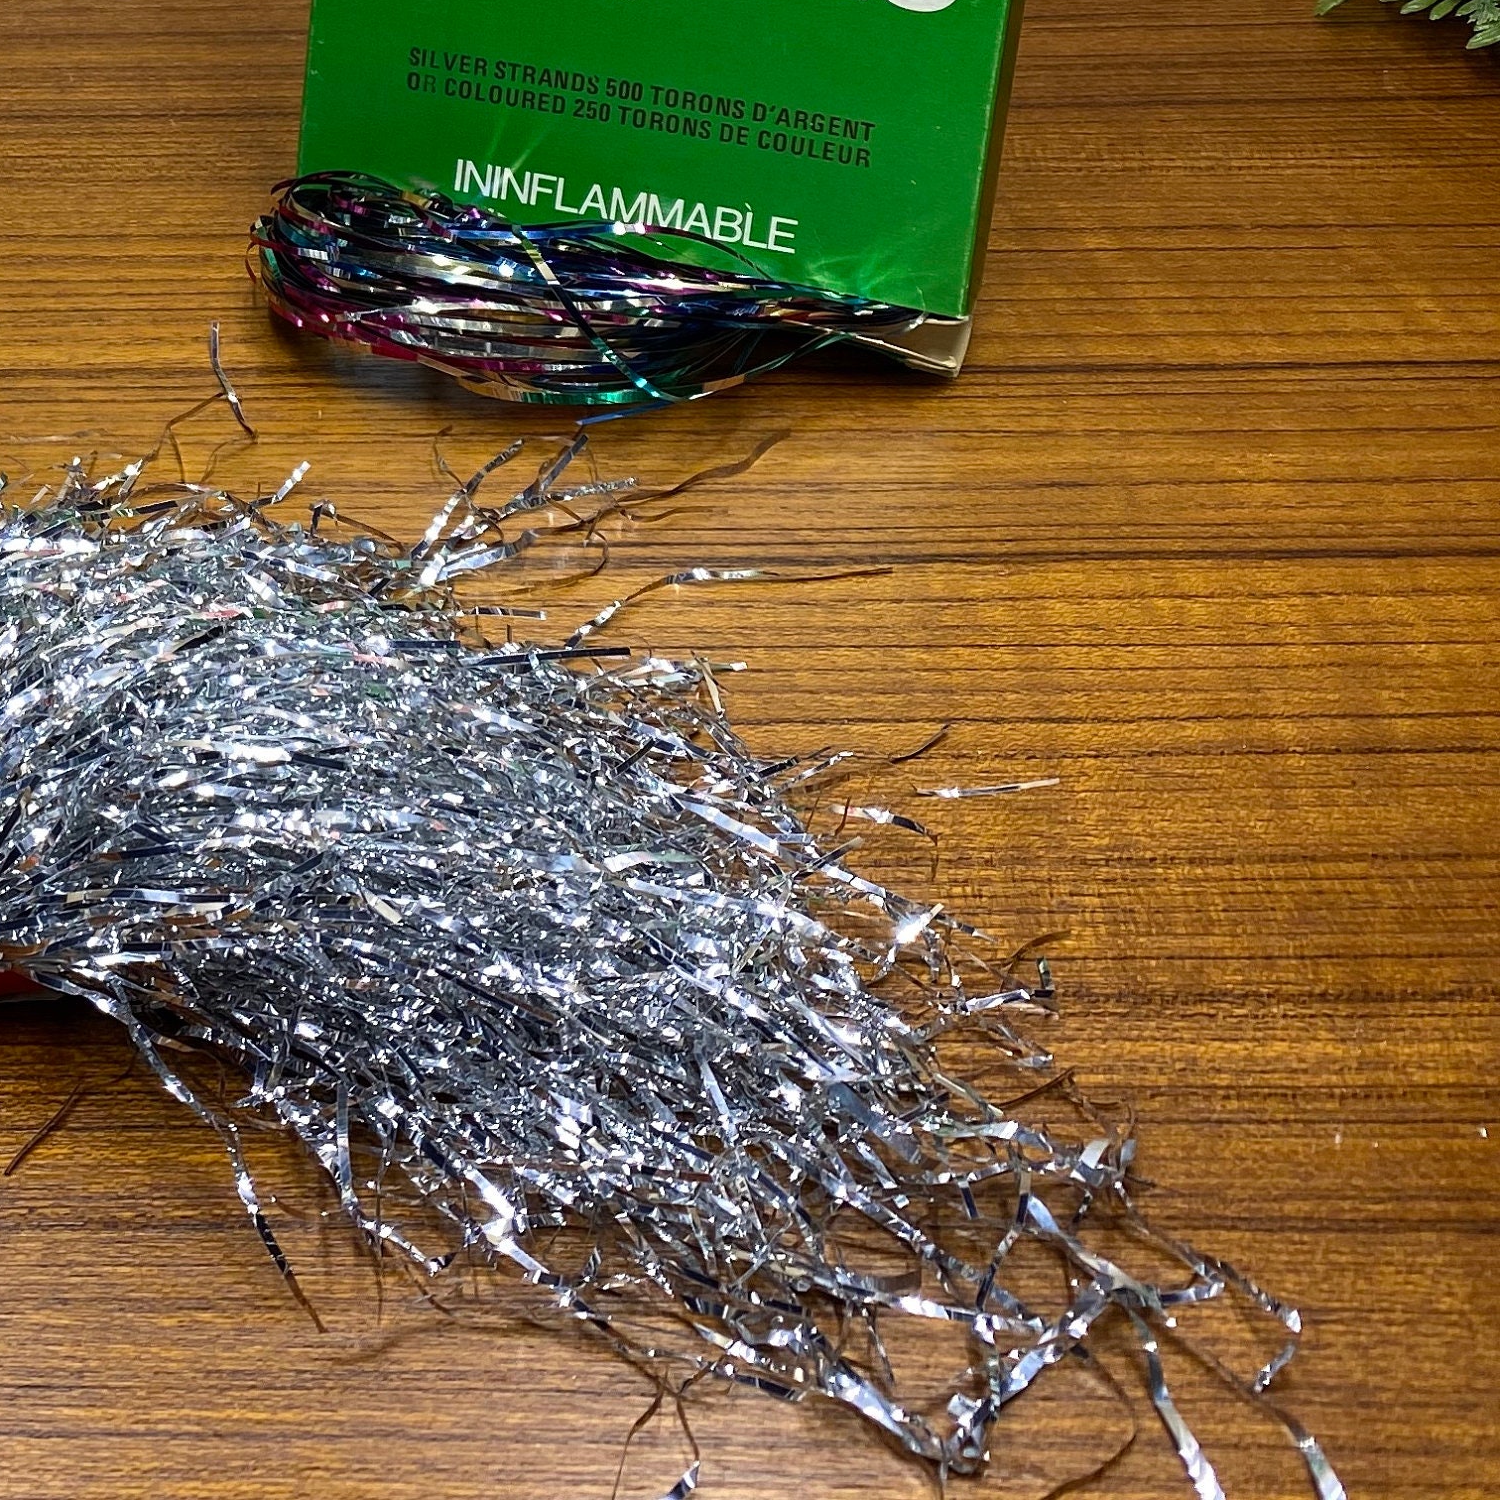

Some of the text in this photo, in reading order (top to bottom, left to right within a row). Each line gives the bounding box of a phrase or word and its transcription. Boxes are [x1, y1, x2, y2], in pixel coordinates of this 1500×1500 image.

[406, 71, 871, 168] OR COLOURED 250 TORONS DE COULEUR
[407, 46, 876, 142] SILVER STRANDS 500 TORONS D'ARGENT
